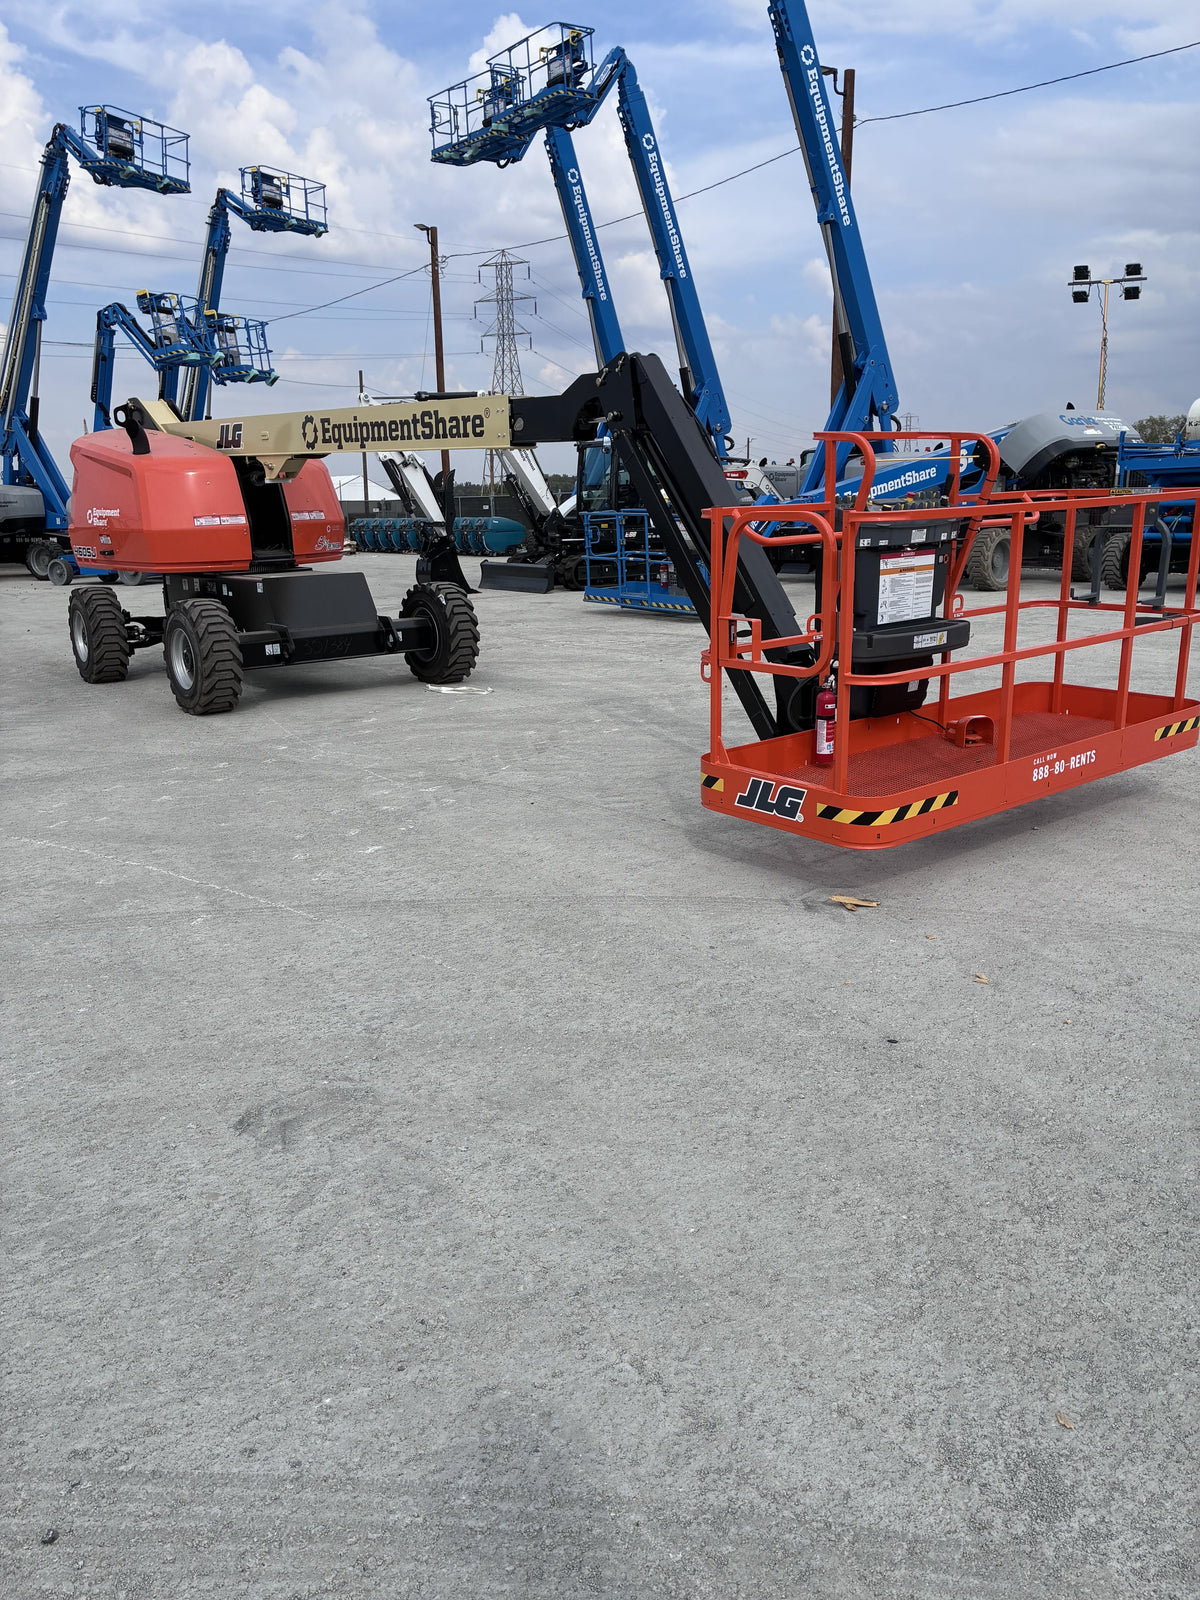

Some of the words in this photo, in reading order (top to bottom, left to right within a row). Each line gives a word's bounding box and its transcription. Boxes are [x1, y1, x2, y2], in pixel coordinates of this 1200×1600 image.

[807, 67, 851, 227] EquipmentShare
[648, 151, 687, 279] EquipmentShare
[572, 185, 607, 301] EquipmentShare
[216, 422, 243, 450] JLG
[843, 466, 937, 499] pmentShare
[93, 507, 120, 518] Equipment
[93, 518, 107, 526] Share
[1032, 749, 1096, 782] 888-80-RENTS
[1033, 756, 1045, 765] CALL
[1046, 752, 1057, 762] NOW
[735, 777, 807, 821] JLG
